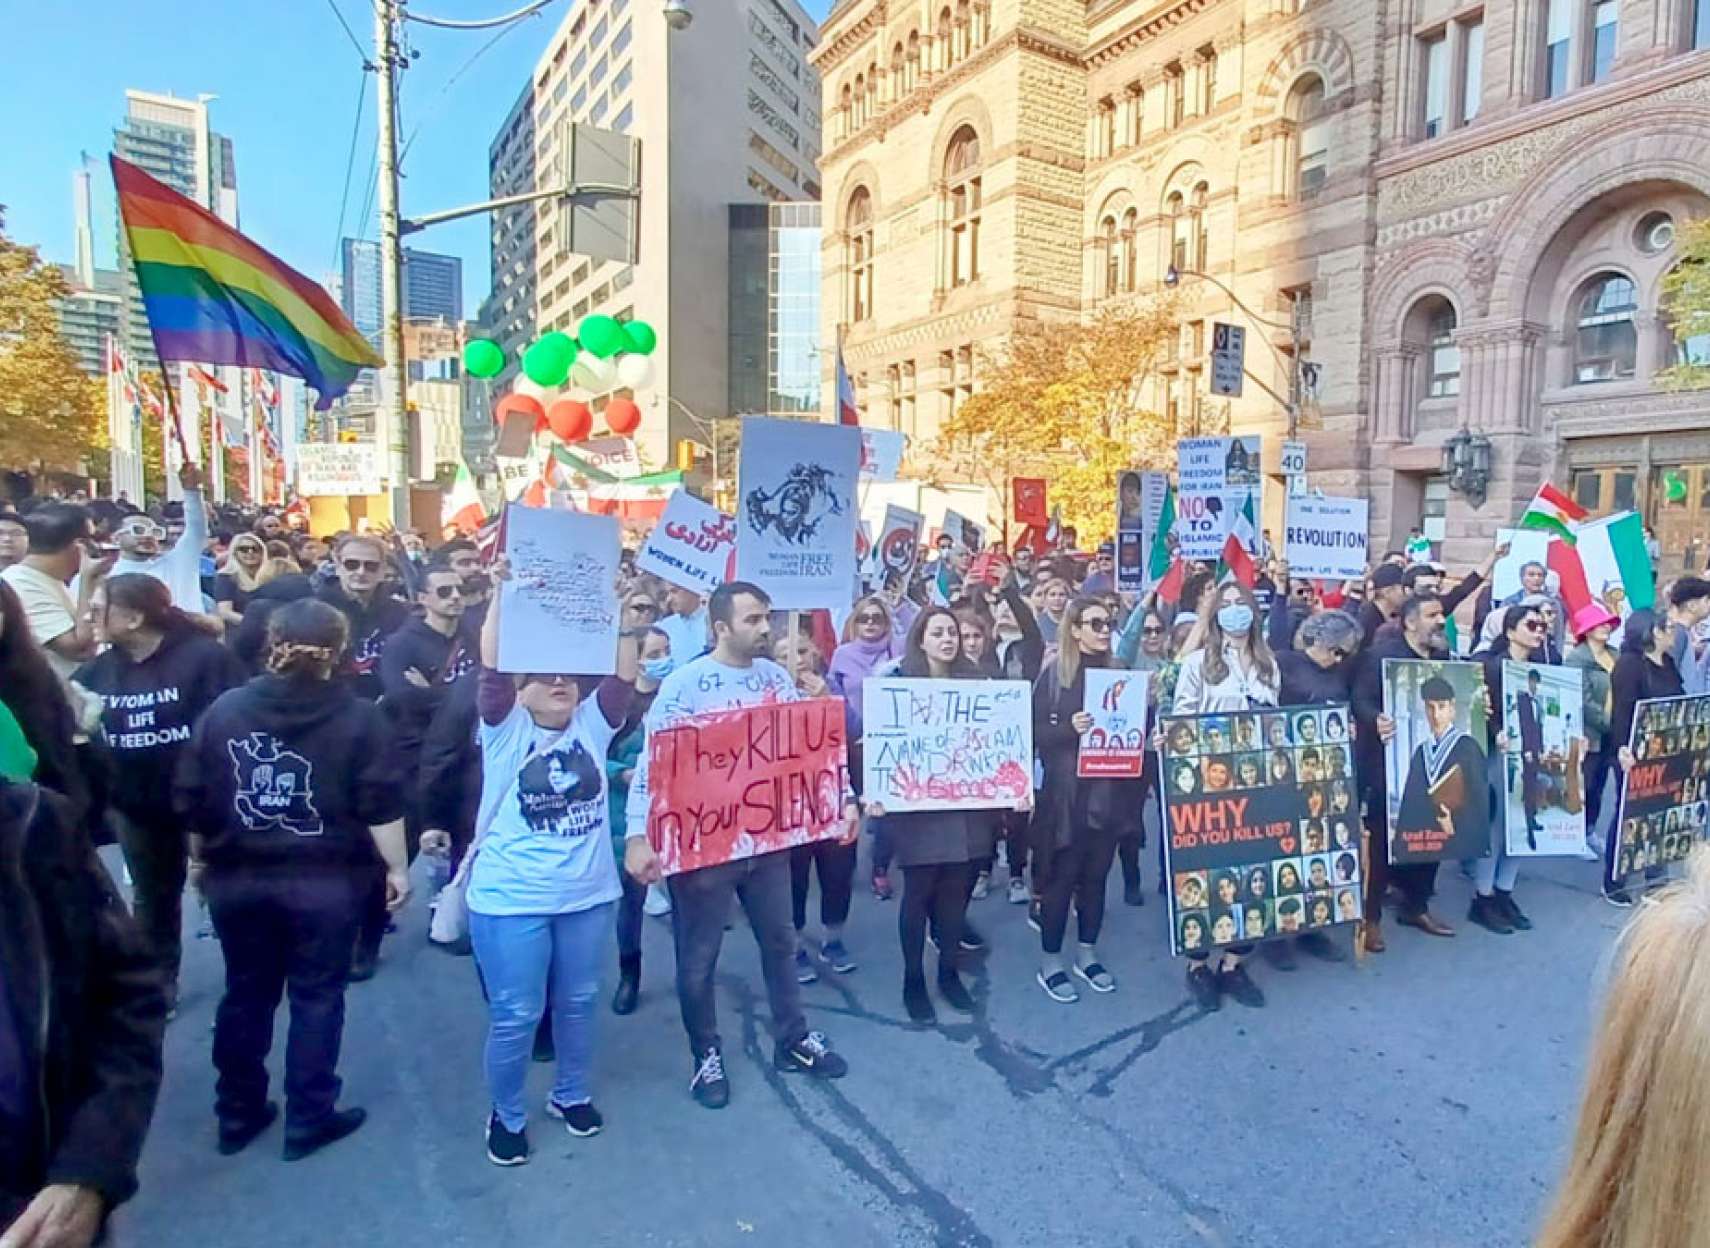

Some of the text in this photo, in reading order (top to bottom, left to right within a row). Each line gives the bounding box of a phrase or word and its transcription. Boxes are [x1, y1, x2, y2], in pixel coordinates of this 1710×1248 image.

[1179, 440, 1221, 449] WOMAN
[1190, 455, 1209, 464] LIFE
[1282, 455, 1304, 470] 40
[1180, 498, 1204, 518] NO
[1190, 520, 1212, 531] TO
[1181, 534, 1223, 542] ISLAMIC
[1287, 527, 1366, 548] REVOLUTION
[801, 553, 832, 564] FREE
[800, 566, 832, 576] IRAN
[941, 690, 991, 723] THE
[748, 711, 801, 770] KILL
[1630, 763, 1667, 791] WHY
[743, 764, 850, 834] SILENCE
[1170, 798, 1249, 835] WHY
[1173, 821, 1291, 849] DID YOU KILL US?
